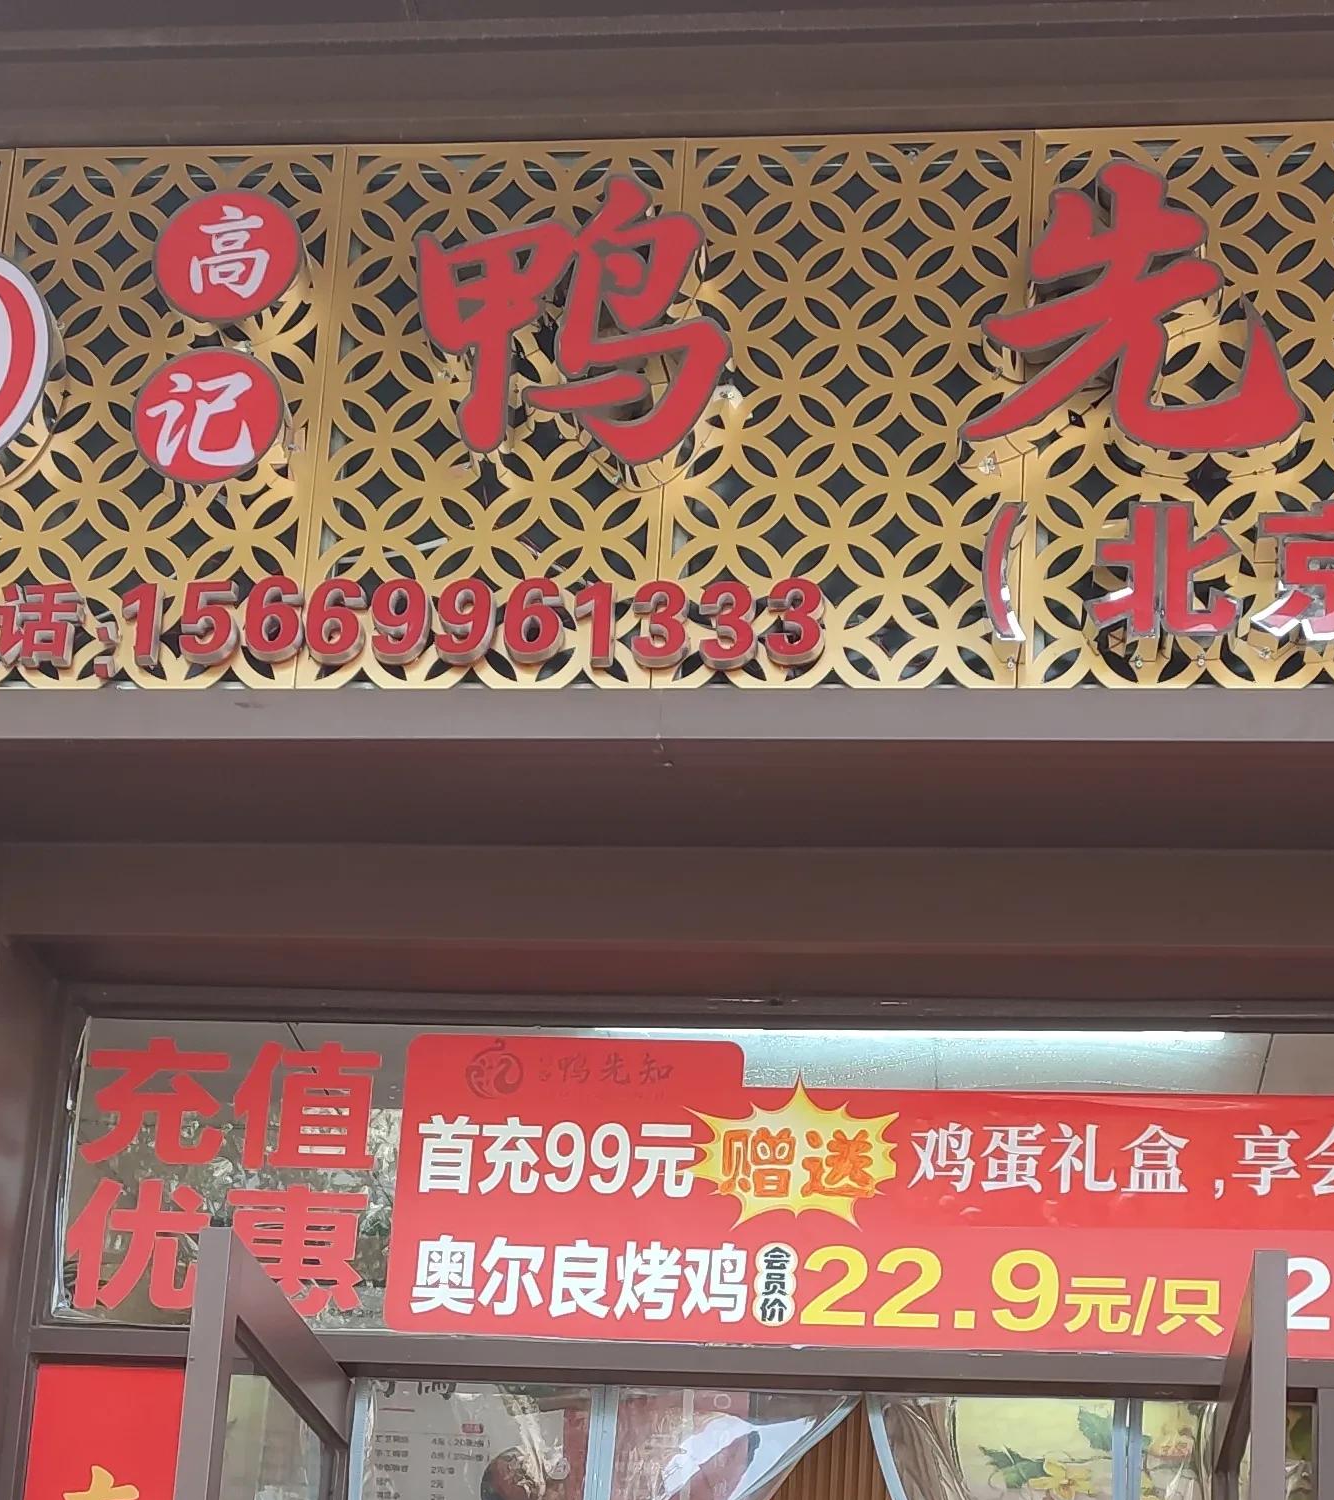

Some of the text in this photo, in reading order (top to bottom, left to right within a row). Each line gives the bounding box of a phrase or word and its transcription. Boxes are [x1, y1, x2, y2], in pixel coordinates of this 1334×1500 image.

[145, 206, 270, 469] 高记
[80, 1037, 381, 1171] 充值
[417, 1115, 695, 1197] 首充99元
[720, 1127, 874, 1200] 赠送
[68, 1178, 363, 1317] 优惠
[410, 1235, 1225, 1338] 奥尔良烤鸡 会员价 22.9元/只
